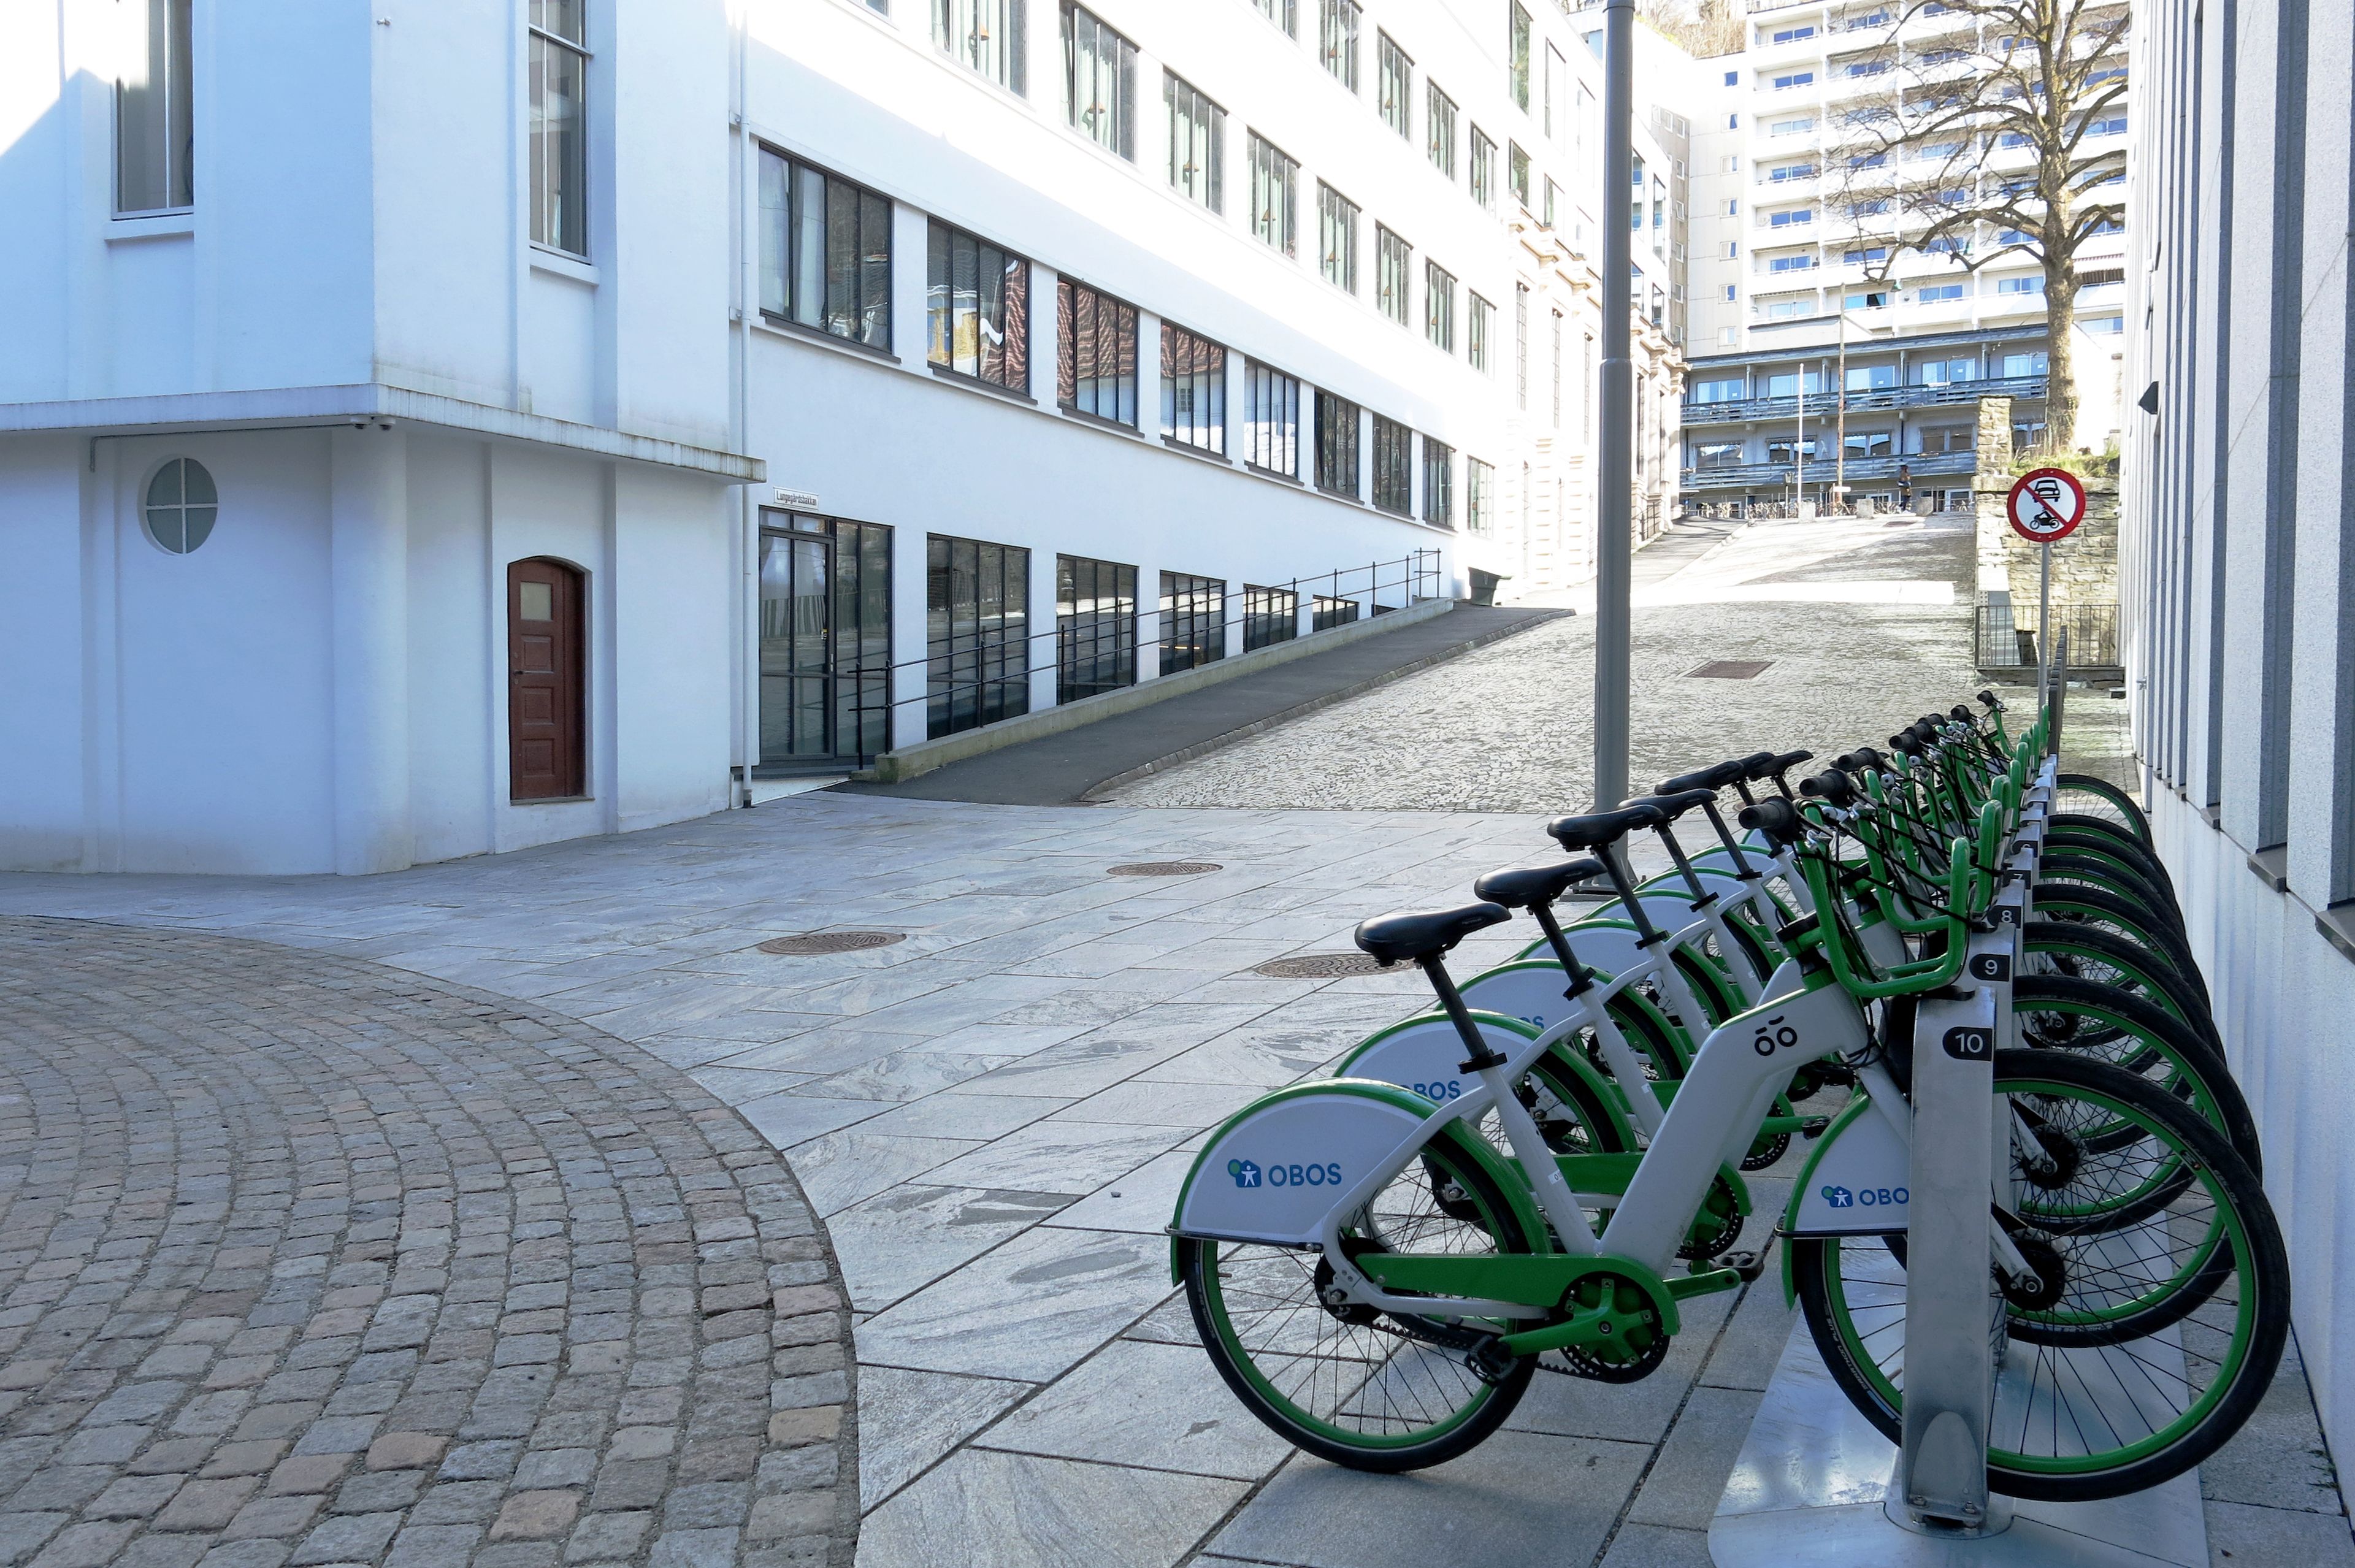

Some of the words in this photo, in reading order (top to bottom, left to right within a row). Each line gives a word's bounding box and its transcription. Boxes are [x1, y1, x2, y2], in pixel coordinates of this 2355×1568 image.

[2001, 909, 2012, 923] 8
[1984, 959, 1998, 976] 9
[1955, 1033, 1984, 1054] 10
[1400, 1080, 1461, 1101] BOS
[1268, 1163, 1342, 1187] OBOS
